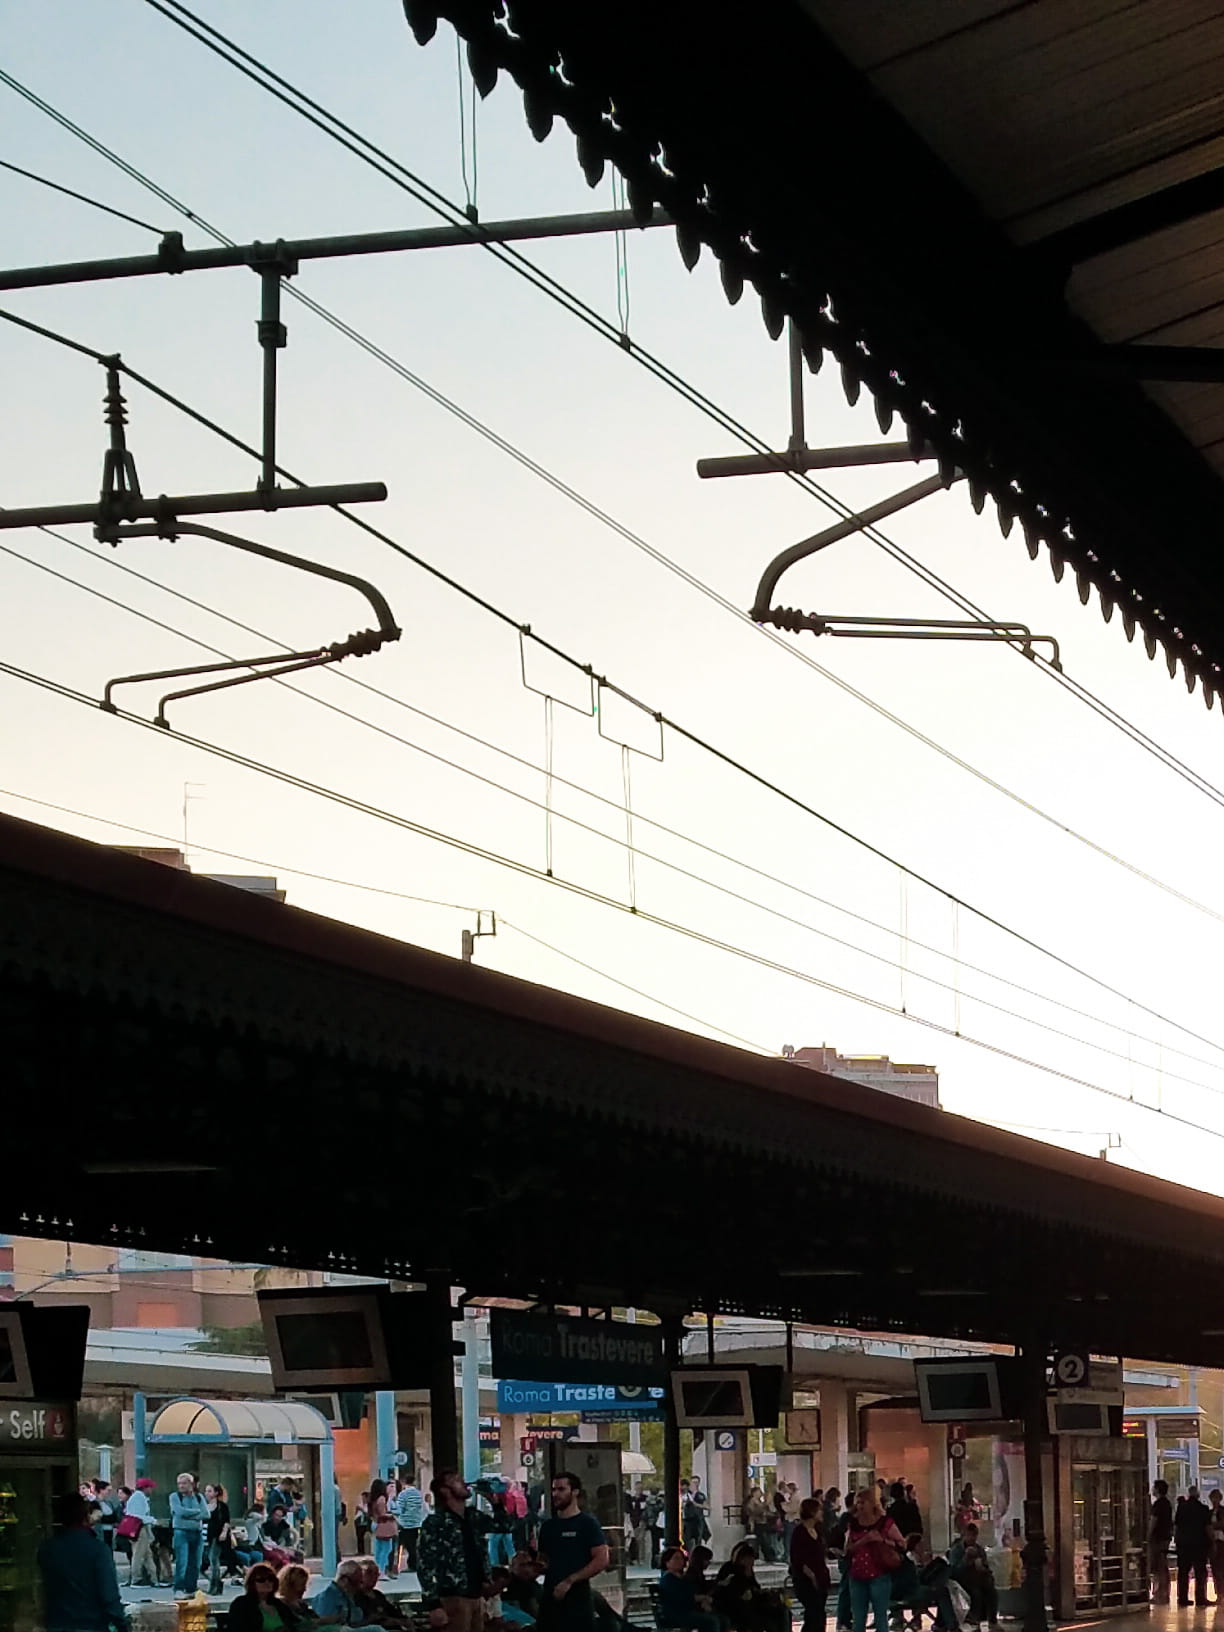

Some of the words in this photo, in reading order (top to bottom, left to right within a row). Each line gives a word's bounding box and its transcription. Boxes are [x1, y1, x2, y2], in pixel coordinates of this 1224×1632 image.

[502, 1326, 553, 1359] Roma
[556, 1321, 657, 1367] Trastevere
[503, 1385, 551, 1403] Roma
[10, 1409, 46, 1440] Self
[480, 1430, 500, 1441] ma
